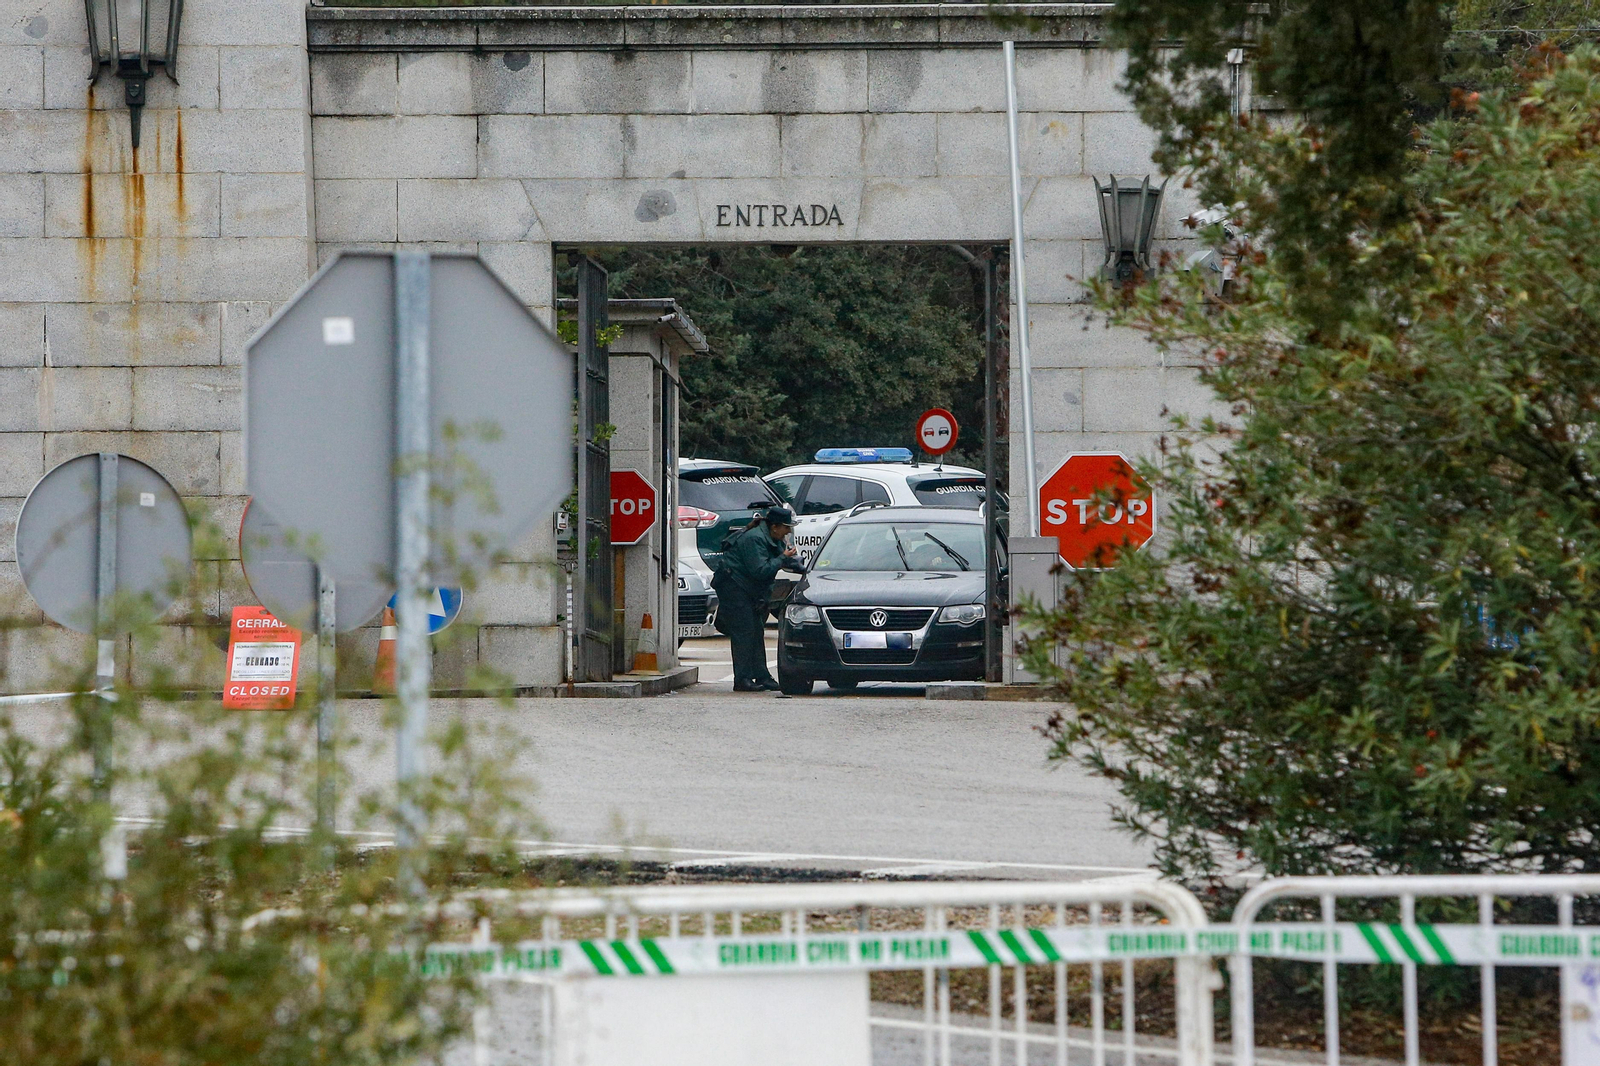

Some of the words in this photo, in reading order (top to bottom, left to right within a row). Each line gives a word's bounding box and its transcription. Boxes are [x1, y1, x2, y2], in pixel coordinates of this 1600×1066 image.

[716, 204, 844, 227] ENTRADA
[702, 475, 740, 486] GUARDIA
[739, 476, 760, 484] CIVIL
[935, 485, 975, 495] GUARDIA
[610, 498, 651, 515] TOP
[1045, 498, 1148, 525] STOP
[795, 535, 825, 546] UARD
[237, 619, 288, 628] CERRAD
[229, 686, 290, 696] CLOSED
[1108, 931, 1187, 952] GUARDIA
[1500, 933, 1580, 956] GUARDIA
[718, 942, 797, 966] GUARDIA
[806, 940, 850, 963] CIVIL
[859, 939, 881, 961] NO
[891, 937, 950, 960] PASAR
